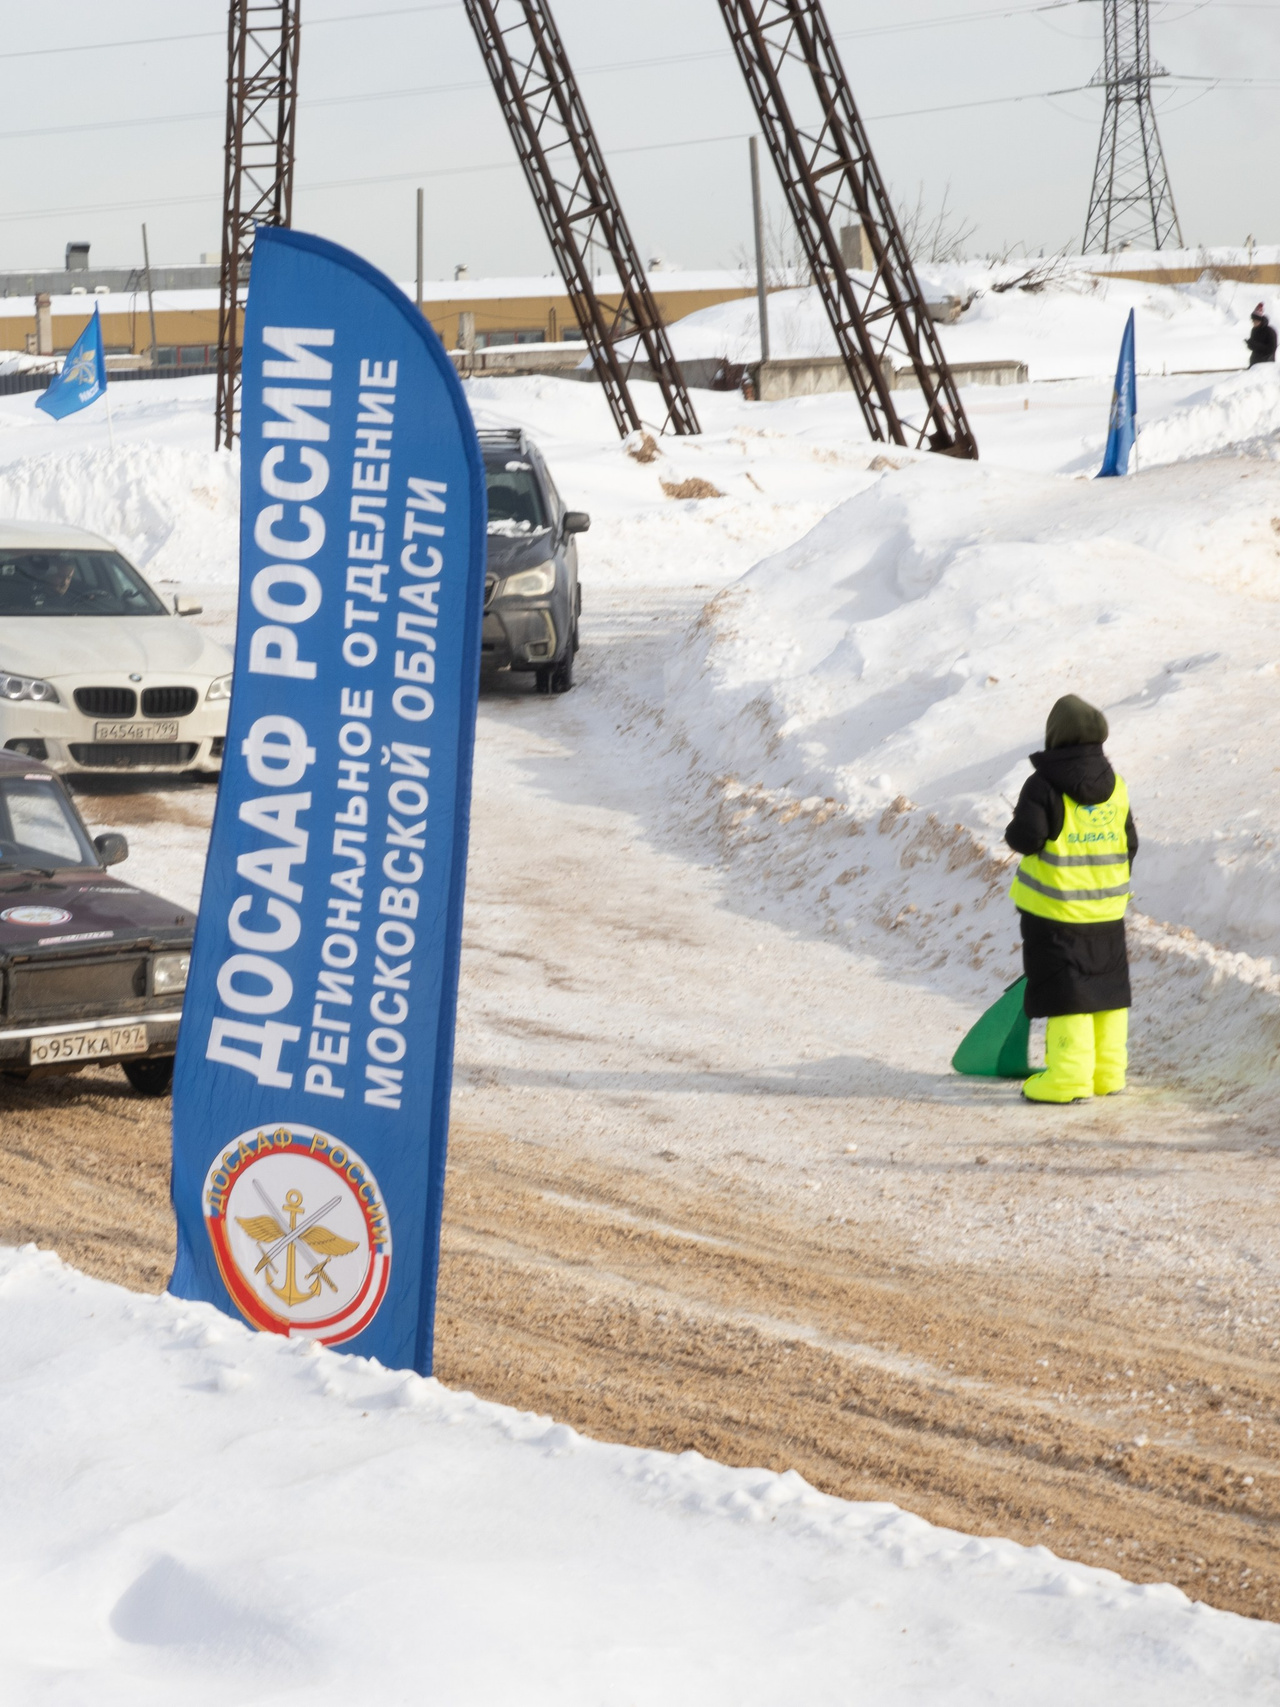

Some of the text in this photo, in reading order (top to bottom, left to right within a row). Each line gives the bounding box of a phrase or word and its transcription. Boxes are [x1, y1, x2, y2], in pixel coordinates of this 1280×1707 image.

[154, 721, 175, 735] 799
[206, 326, 335, 1089] ДОСААФ РОССИИ
[305, 358, 398, 1099] РЕГИОНАЛЬНОЕ ОТДЕЛЕНИЕ
[364, 477, 447, 1110] МОСКОВСКОЙ ОБЛАСТИ
[36, 1028, 140, 1060] О957КА 797
[206, 1127, 388, 1244] ДОСААФ РОССИИ
